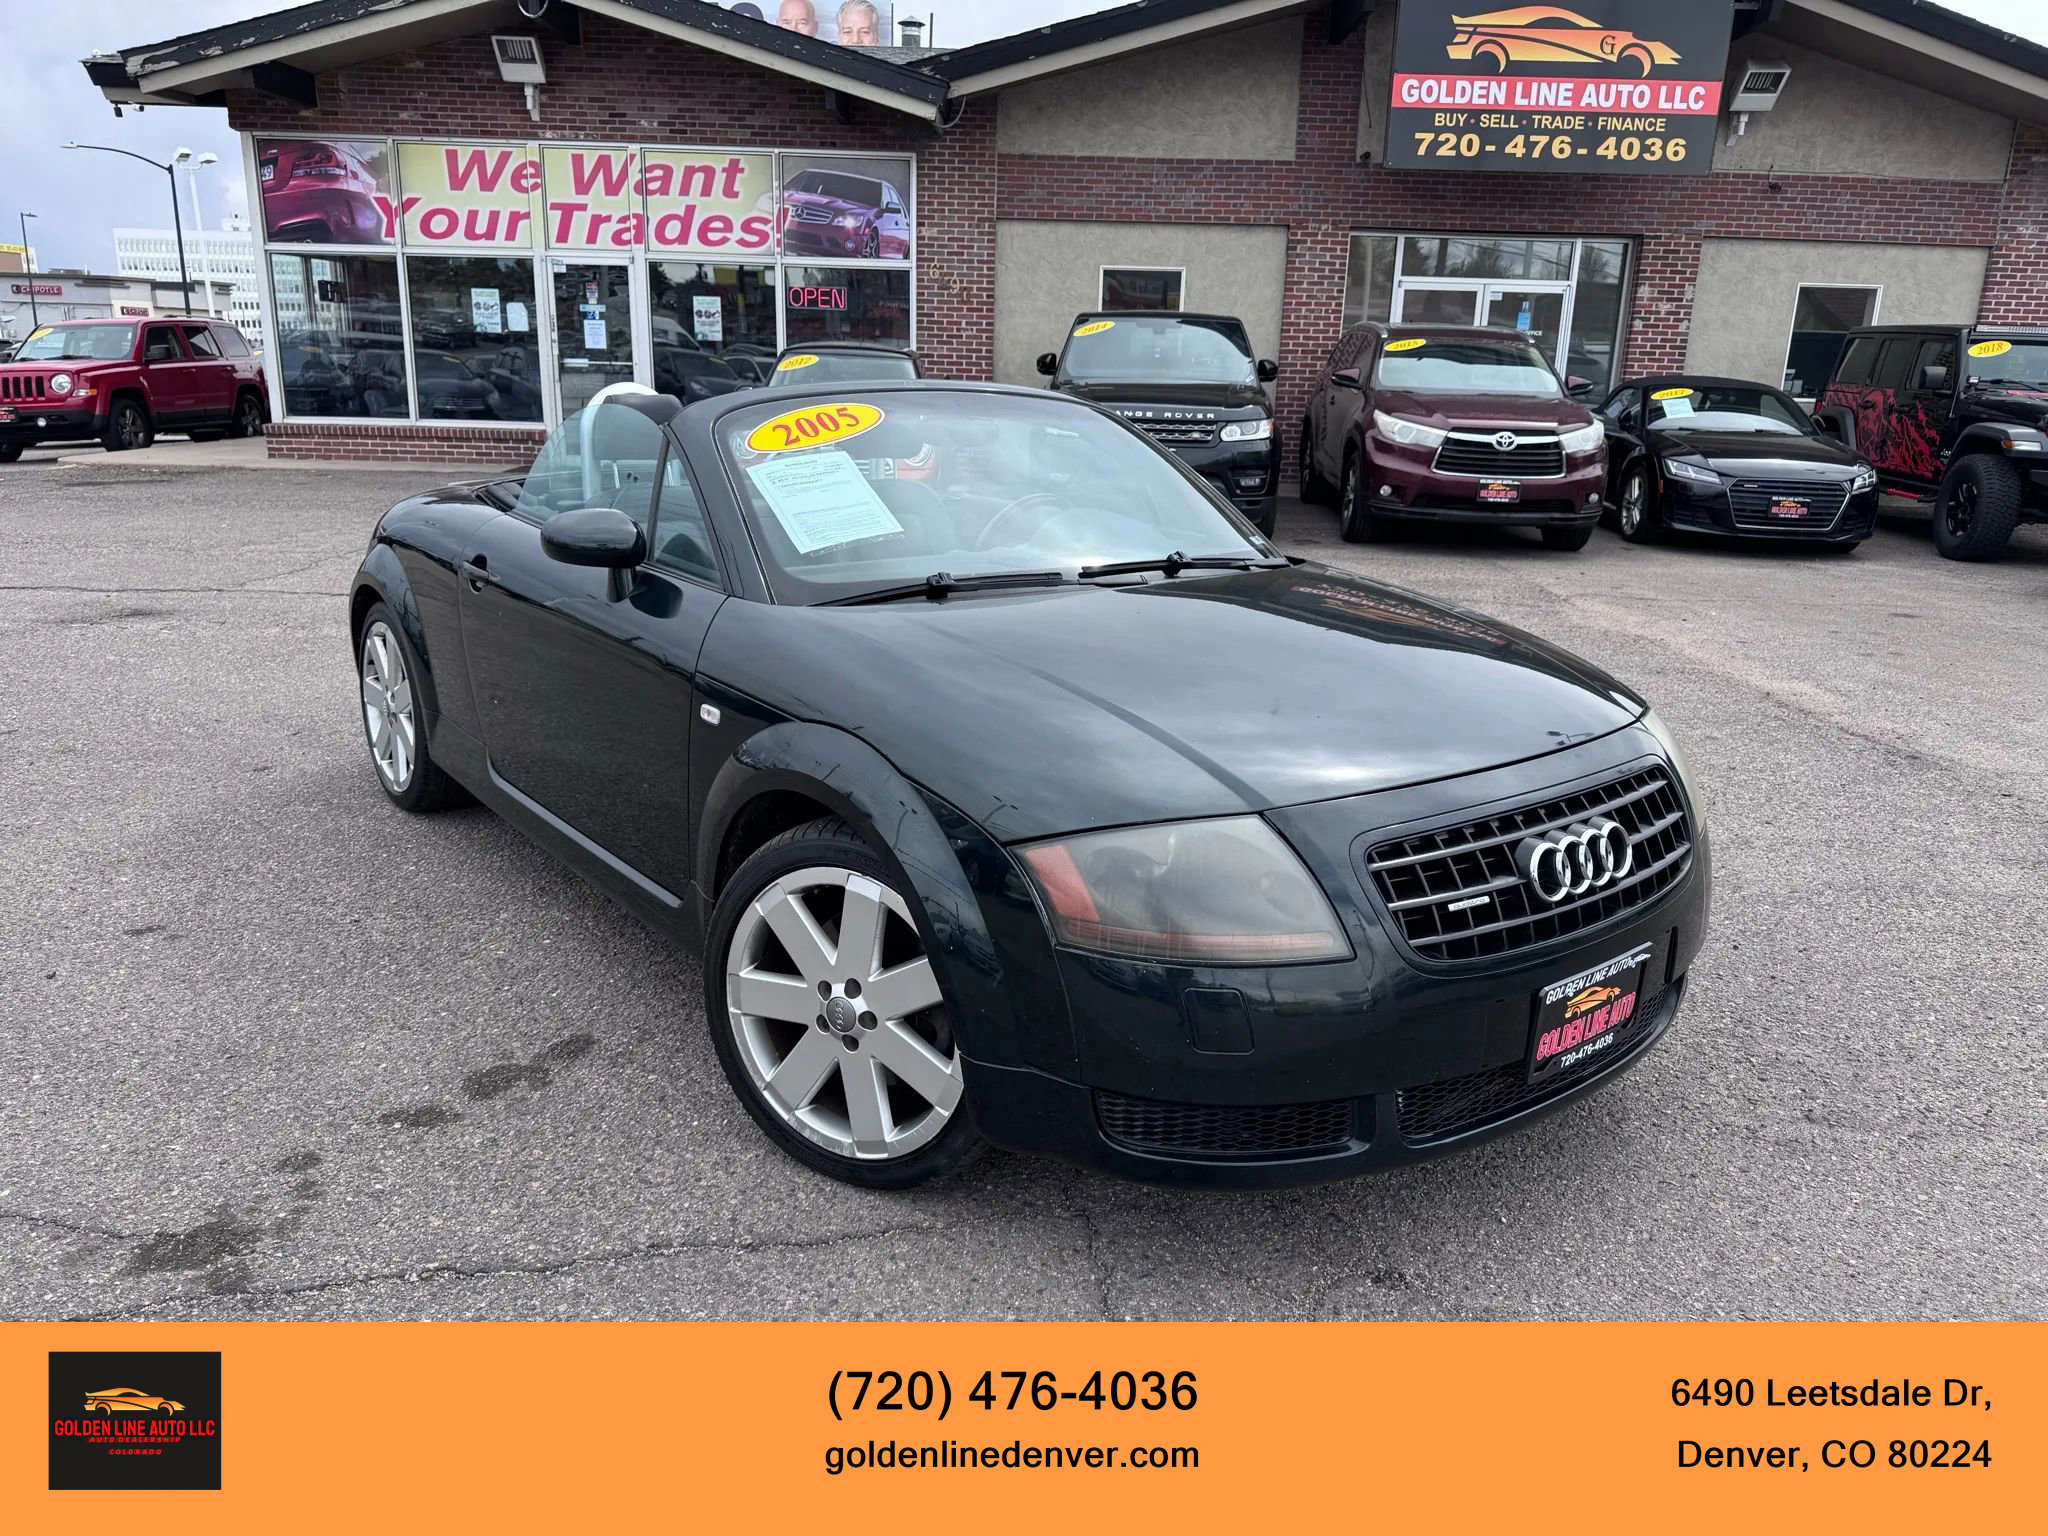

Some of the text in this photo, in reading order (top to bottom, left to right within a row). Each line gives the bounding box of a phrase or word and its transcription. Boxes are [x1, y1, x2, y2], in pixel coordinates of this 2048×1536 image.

[1401, 78, 1706, 111] GOLDEN LINE AUTO LLC
[1434, 112, 1667, 132] BUY SELL TRADE FINANCE
[443, 148, 745, 199] We Want
[371, 196, 790, 248] Your Trades!
[789, 286, 846, 309] OPEN
[1977, 342, 2003, 355] 2018
[772, 406, 860, 446] 2005
[1116, 409, 1215, 419] ANGE ROVER
[1546, 957, 1632, 1005] GOLDEN LINE AUTO
[1536, 992, 1637, 1061] GOLDEN LINE AUTO
[1560, 1033, 1614, 1068] 720-476-4036
